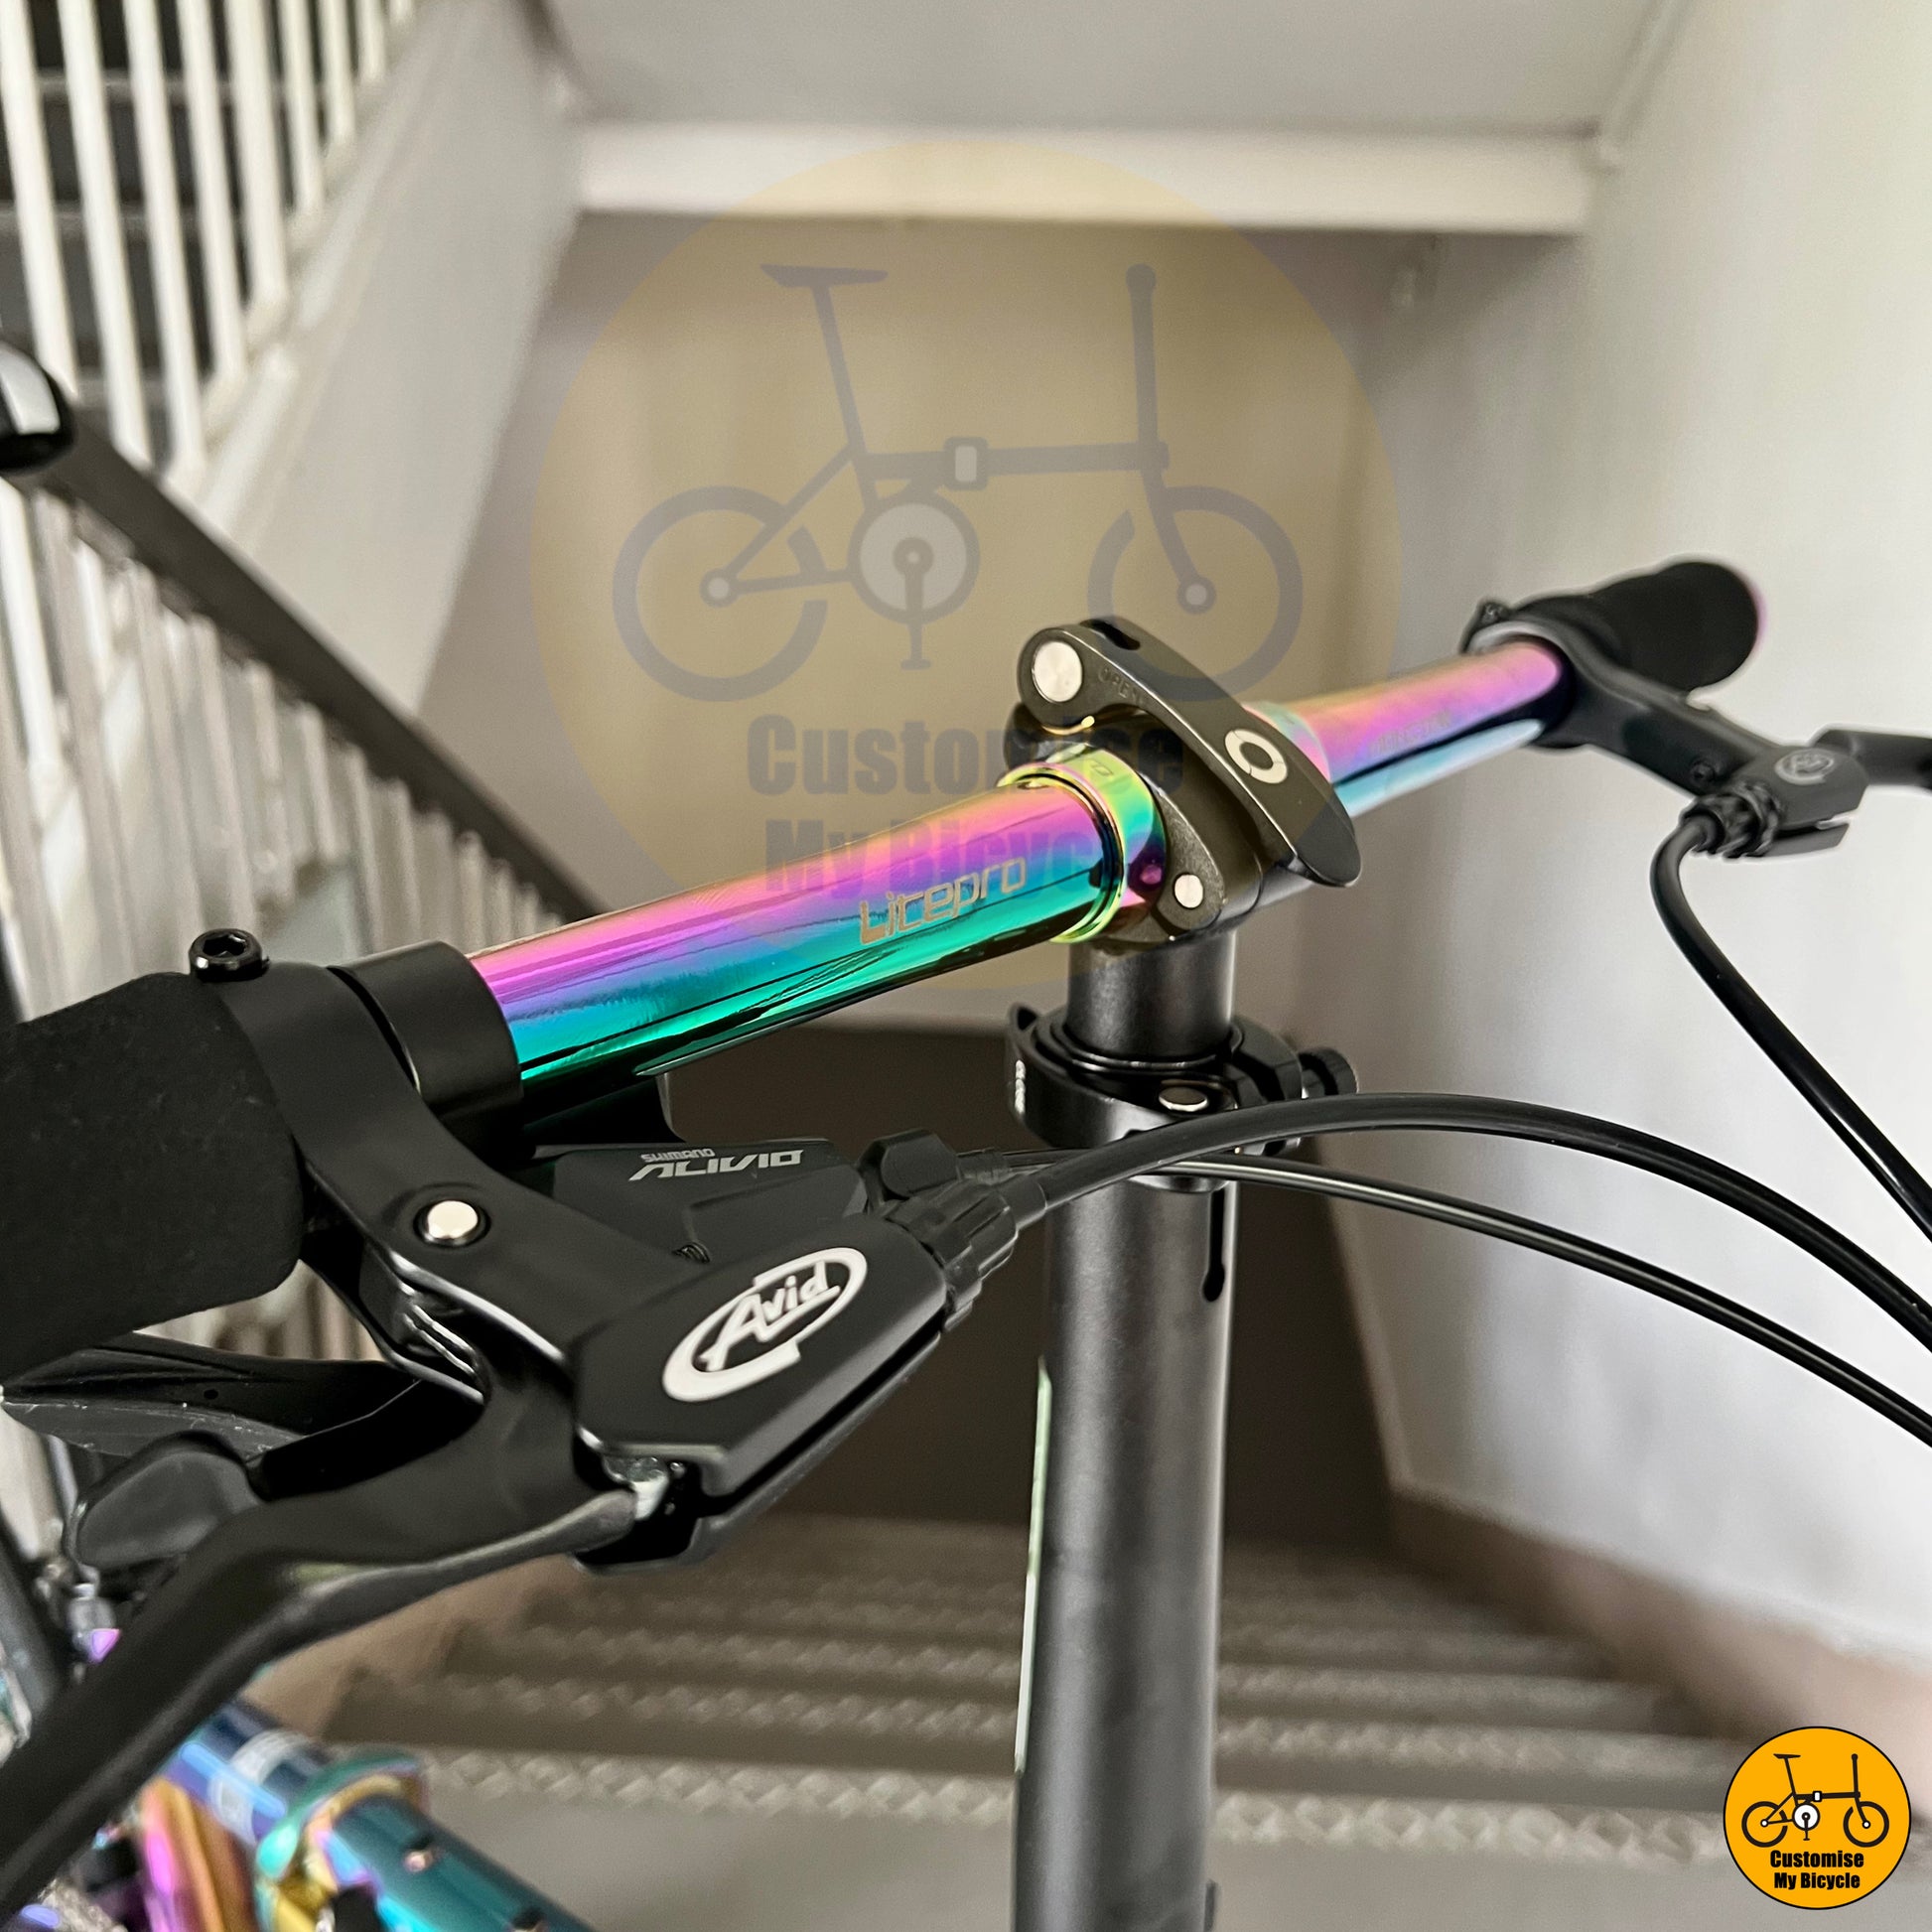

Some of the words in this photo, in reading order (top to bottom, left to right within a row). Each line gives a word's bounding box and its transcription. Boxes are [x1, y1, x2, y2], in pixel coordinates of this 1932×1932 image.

[628, 1150, 804, 1181] ALIVIO
[640, 1148, 716, 1163] SHIMANO
[698, 1260, 841, 1371] Avid
